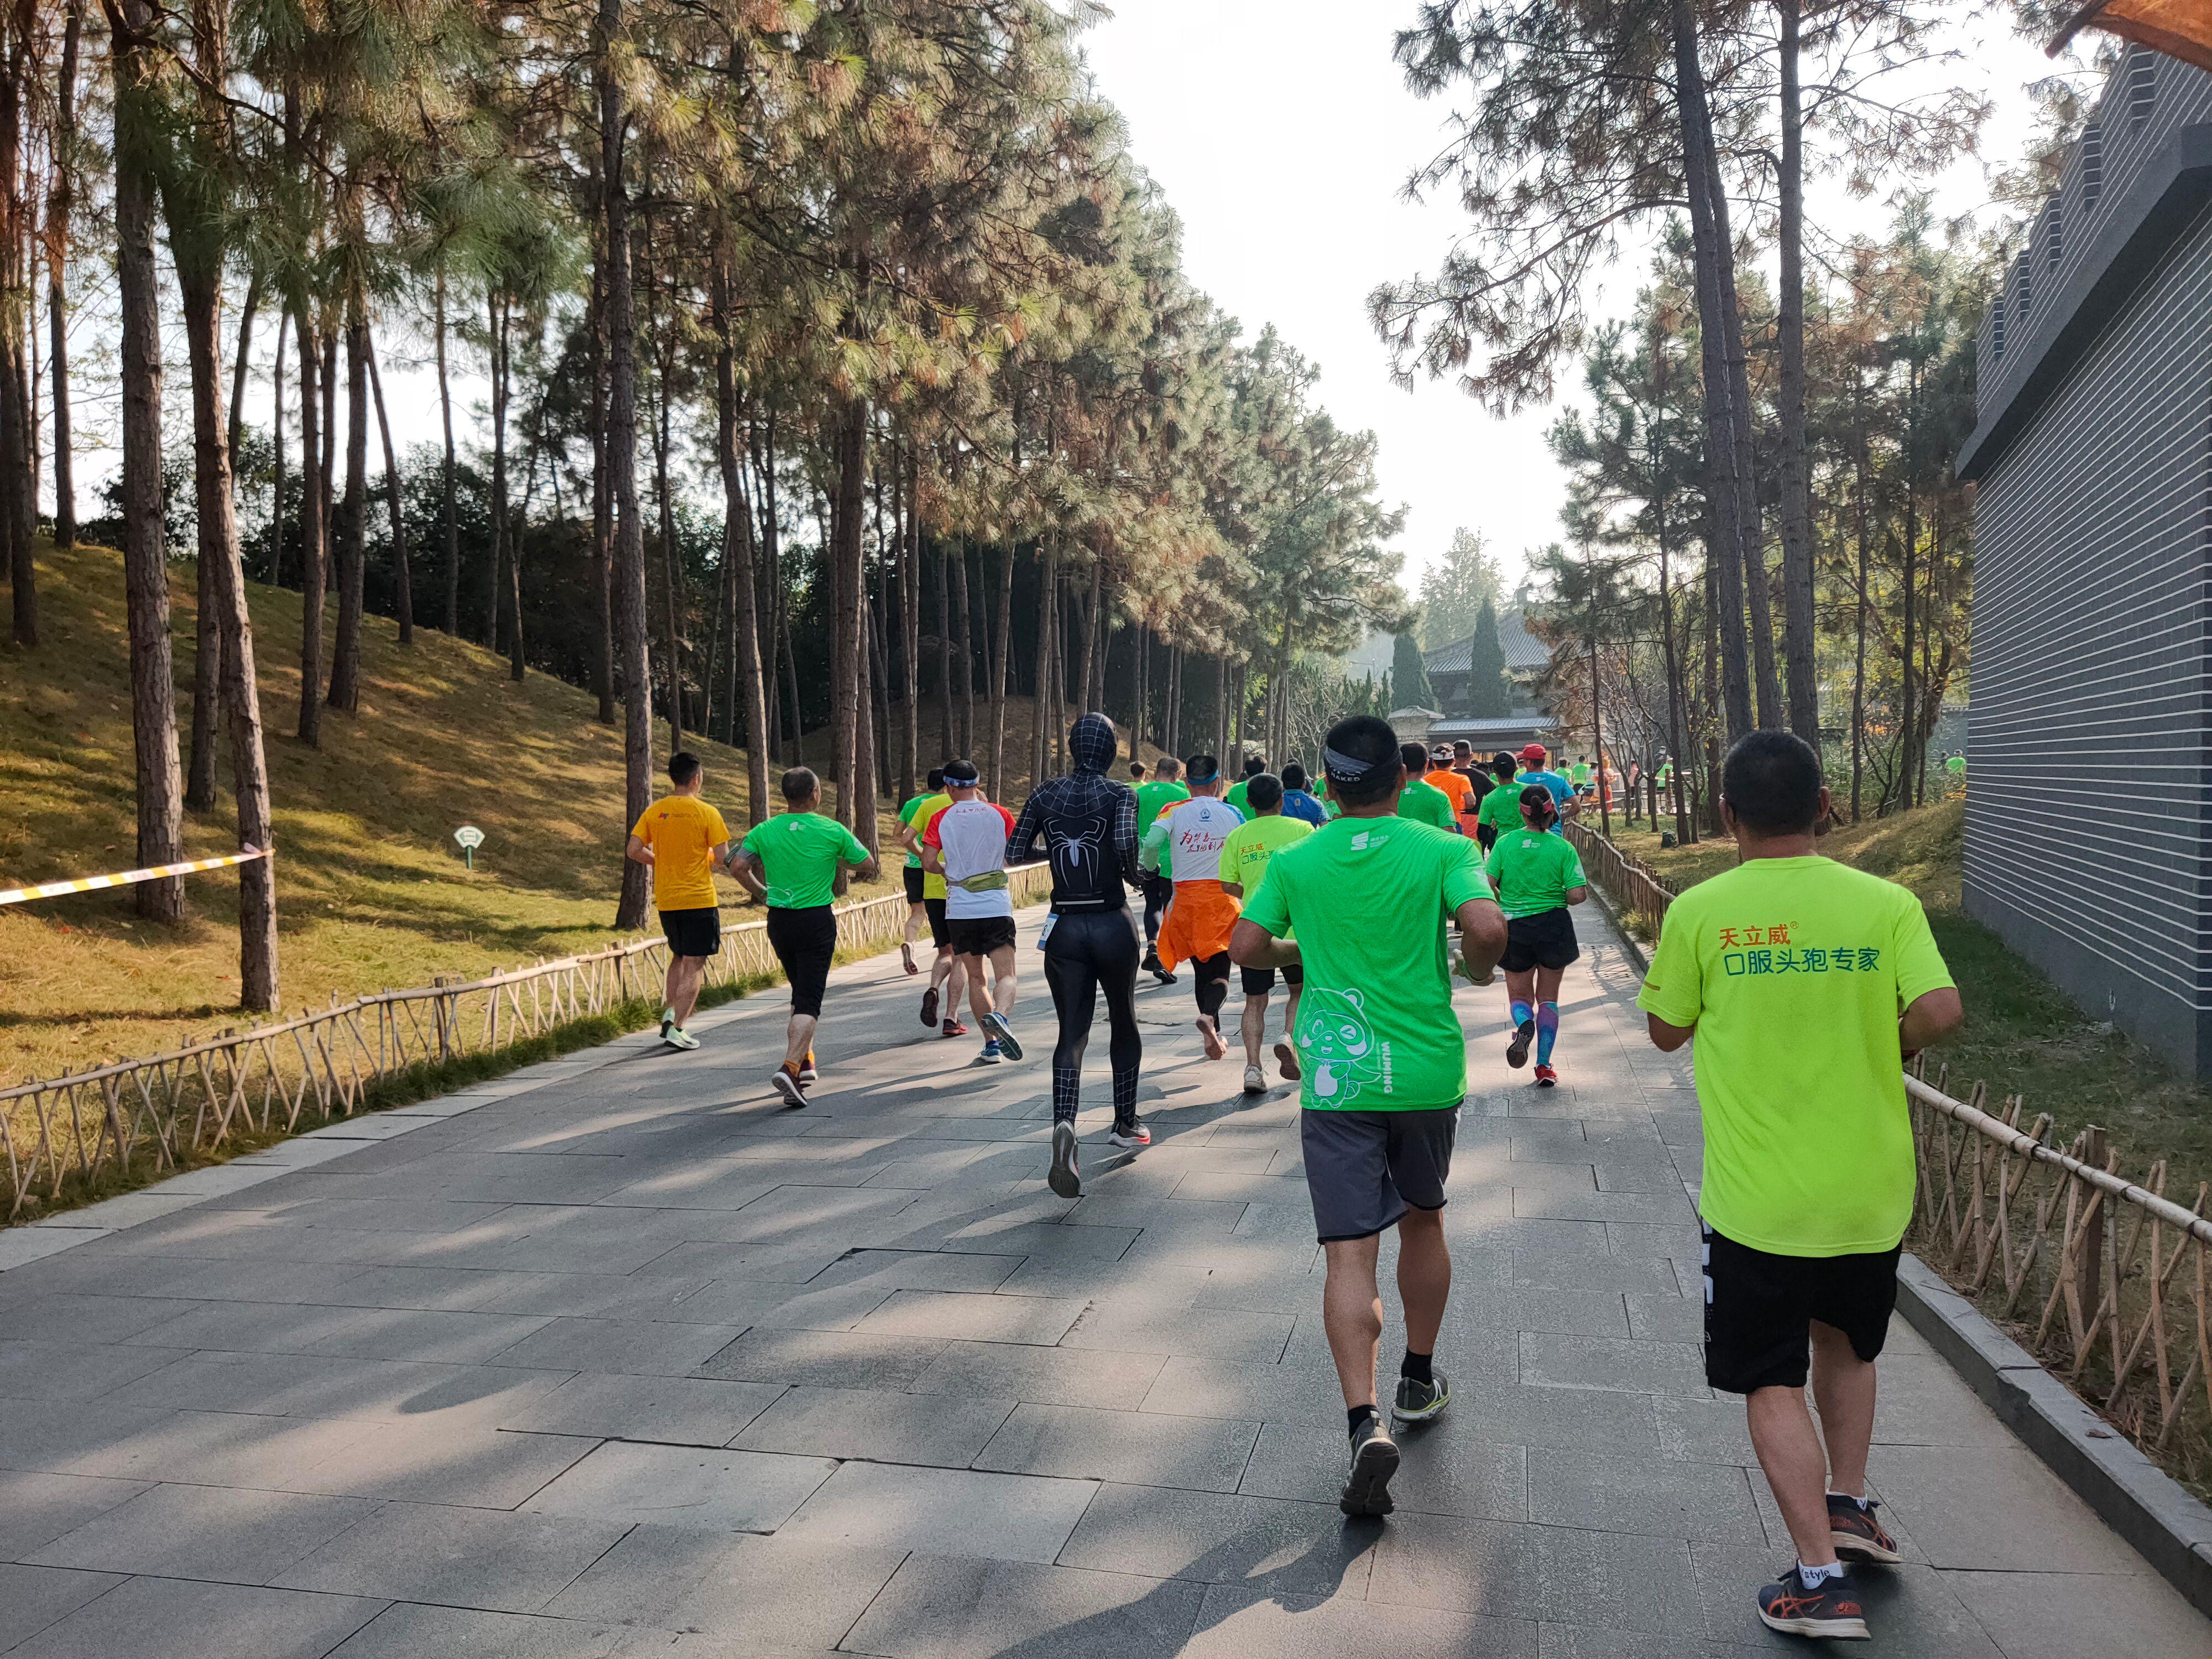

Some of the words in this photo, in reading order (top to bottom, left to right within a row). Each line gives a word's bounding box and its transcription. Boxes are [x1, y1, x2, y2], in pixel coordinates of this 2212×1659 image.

[1724, 946, 1880, 976] 口服头孢专家
[1381, 1041, 1392, 1093] WUMING
